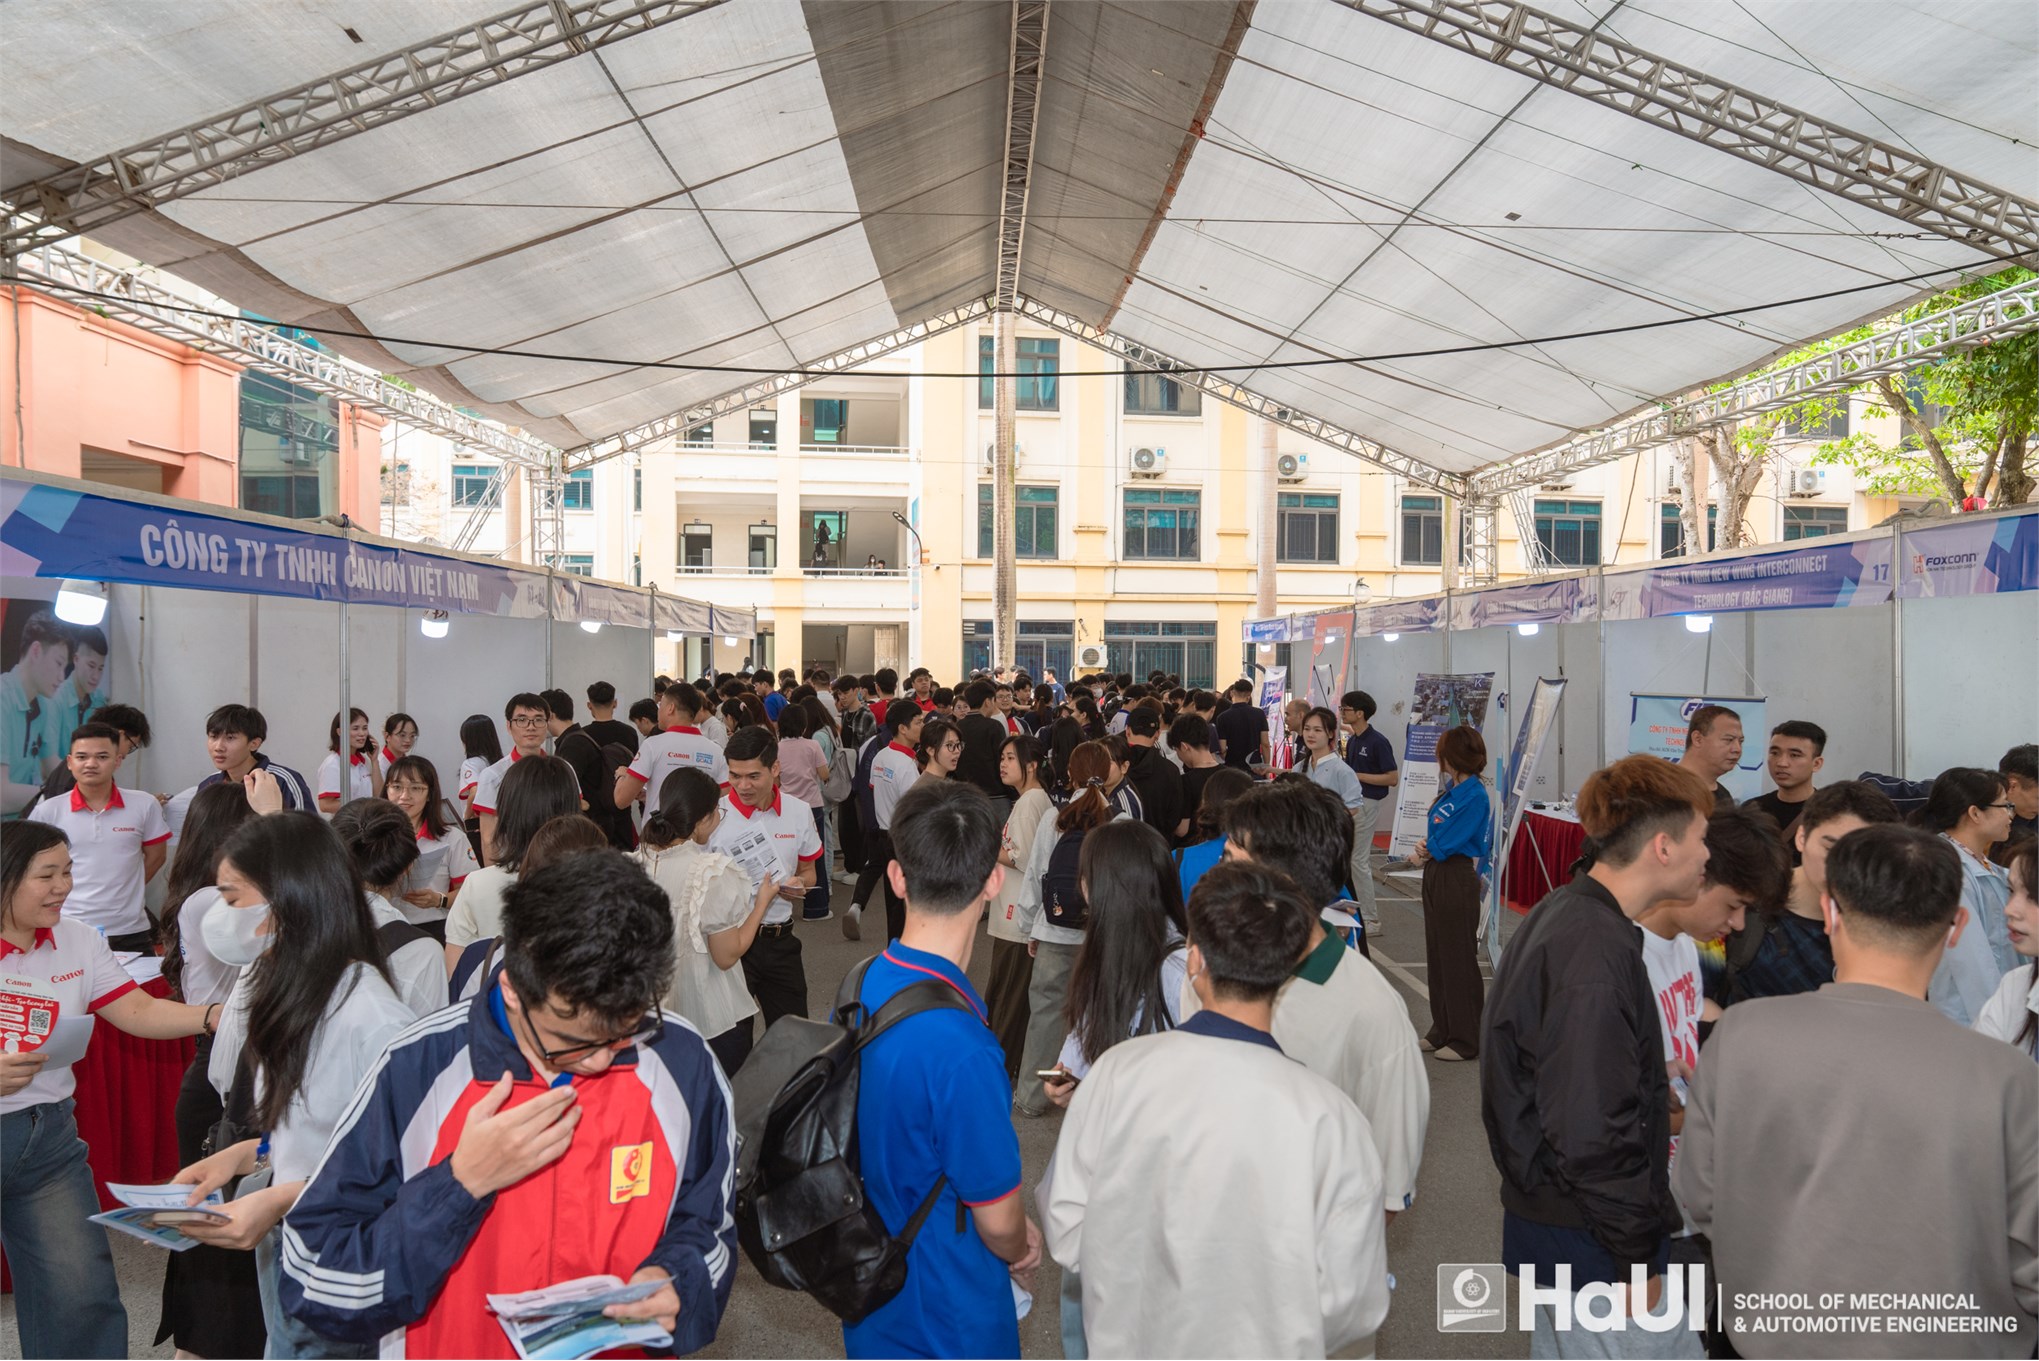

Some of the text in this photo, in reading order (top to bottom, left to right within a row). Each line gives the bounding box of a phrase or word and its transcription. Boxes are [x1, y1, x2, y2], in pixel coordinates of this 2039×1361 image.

[140, 519, 479, 602] CÔNG TY TNHH CANON VIỆT NAM
[1680, 571, 1690, 585] TY
[1711, 567, 1731, 581] NEW
[1731, 563, 1755, 580] WING
[1756, 554, 1828, 578] INTERCONNECT
[1873, 563, 1889, 581] 17
[1693, 591, 1740, 609] TECHNOLOGY
[1763, 587, 1793, 605] GIANG)
[667, 751, 690, 759] Canon
[5, 978, 32, 988] Canon
